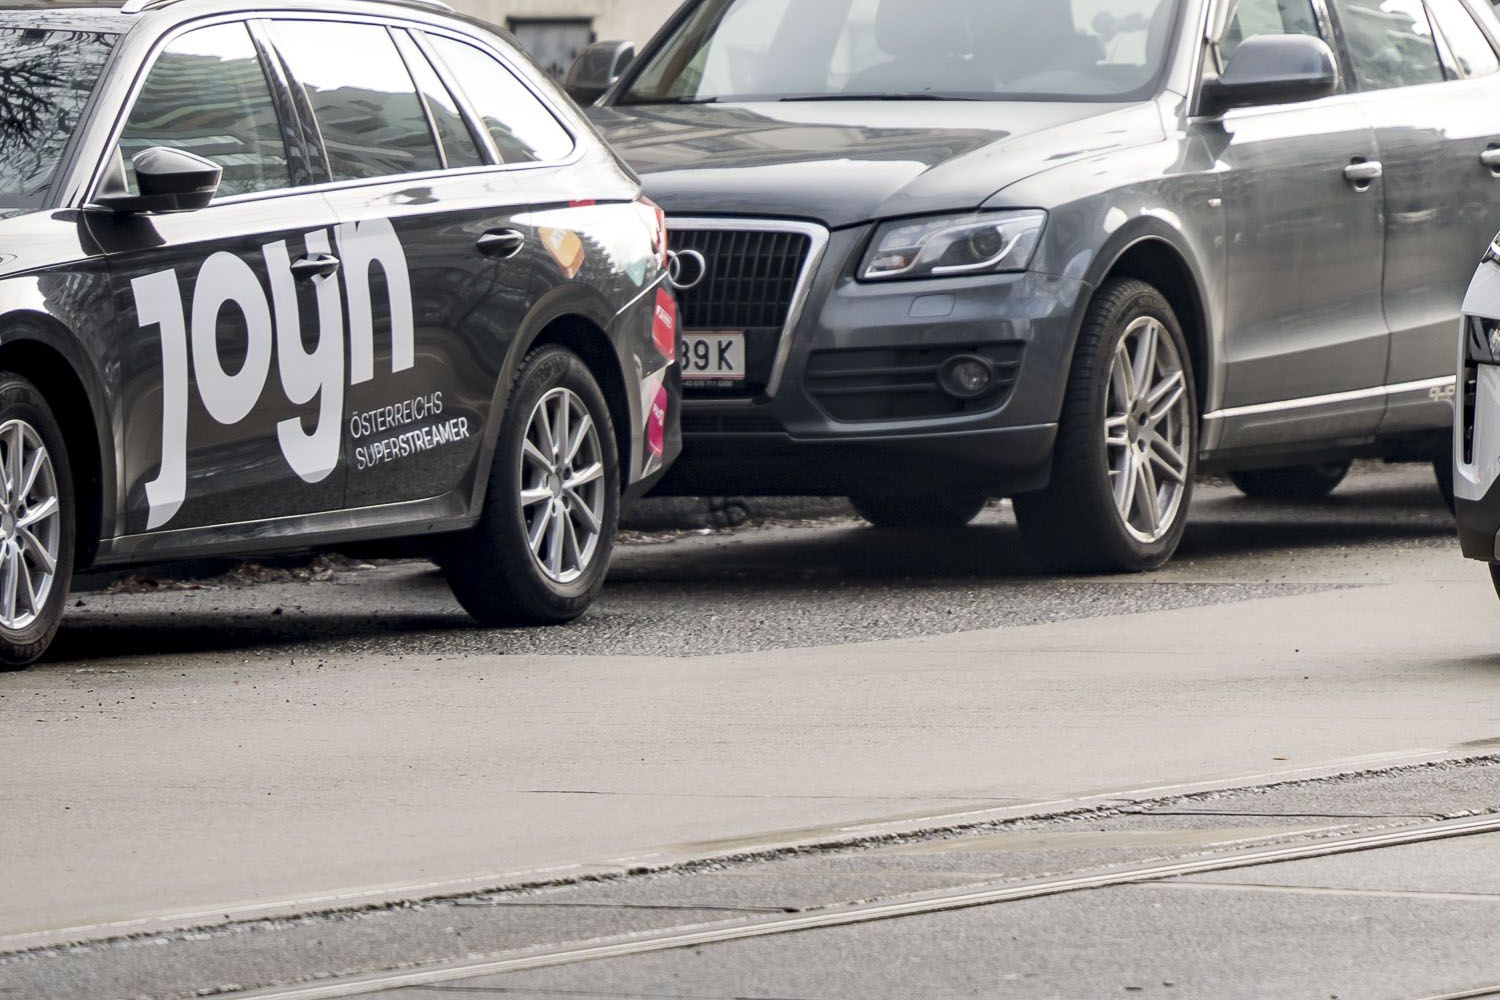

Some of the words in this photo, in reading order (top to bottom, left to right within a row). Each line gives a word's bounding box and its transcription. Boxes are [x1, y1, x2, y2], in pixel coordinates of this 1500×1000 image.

[130, 217, 415, 531] joyn
[717, 339, 734, 371] K
[350, 391, 443, 439] ÖSTERREICHS
[355, 416, 470, 470] SUPERSTREAMER
